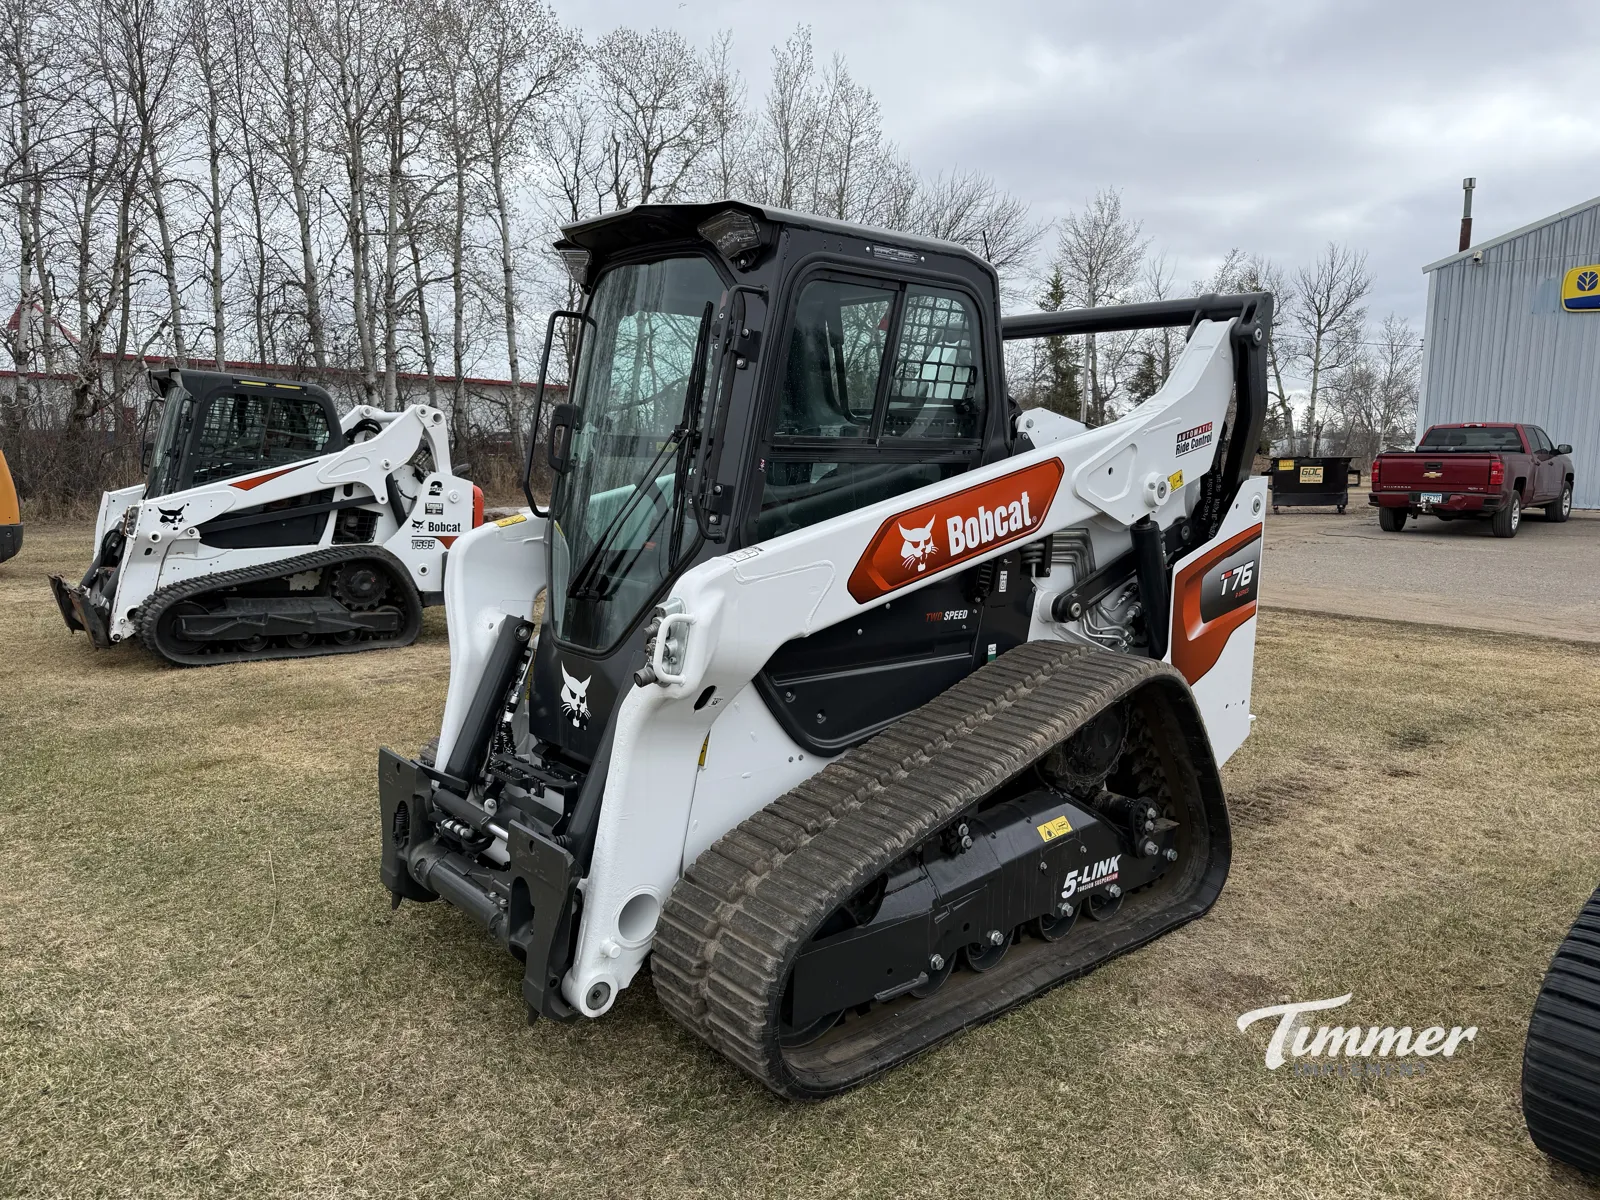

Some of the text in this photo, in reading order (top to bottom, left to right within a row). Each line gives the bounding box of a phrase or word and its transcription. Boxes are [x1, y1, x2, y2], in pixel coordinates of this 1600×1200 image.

[1177, 423, 1212, 443] AUTOMATIC
[1176, 431, 1212, 455] Ride Control
[1302, 468, 1322, 476] GDC
[428, 481, 443, 496] 2
[428, 521, 461, 532] Bobcat
[946, 491, 1032, 557] Bobcat
[411, 540, 435, 549] T595
[1220, 560, 1255, 596] T76
[926, 609, 969, 622] TWO SPEED
[1061, 854, 1122, 899] 5-LINK
